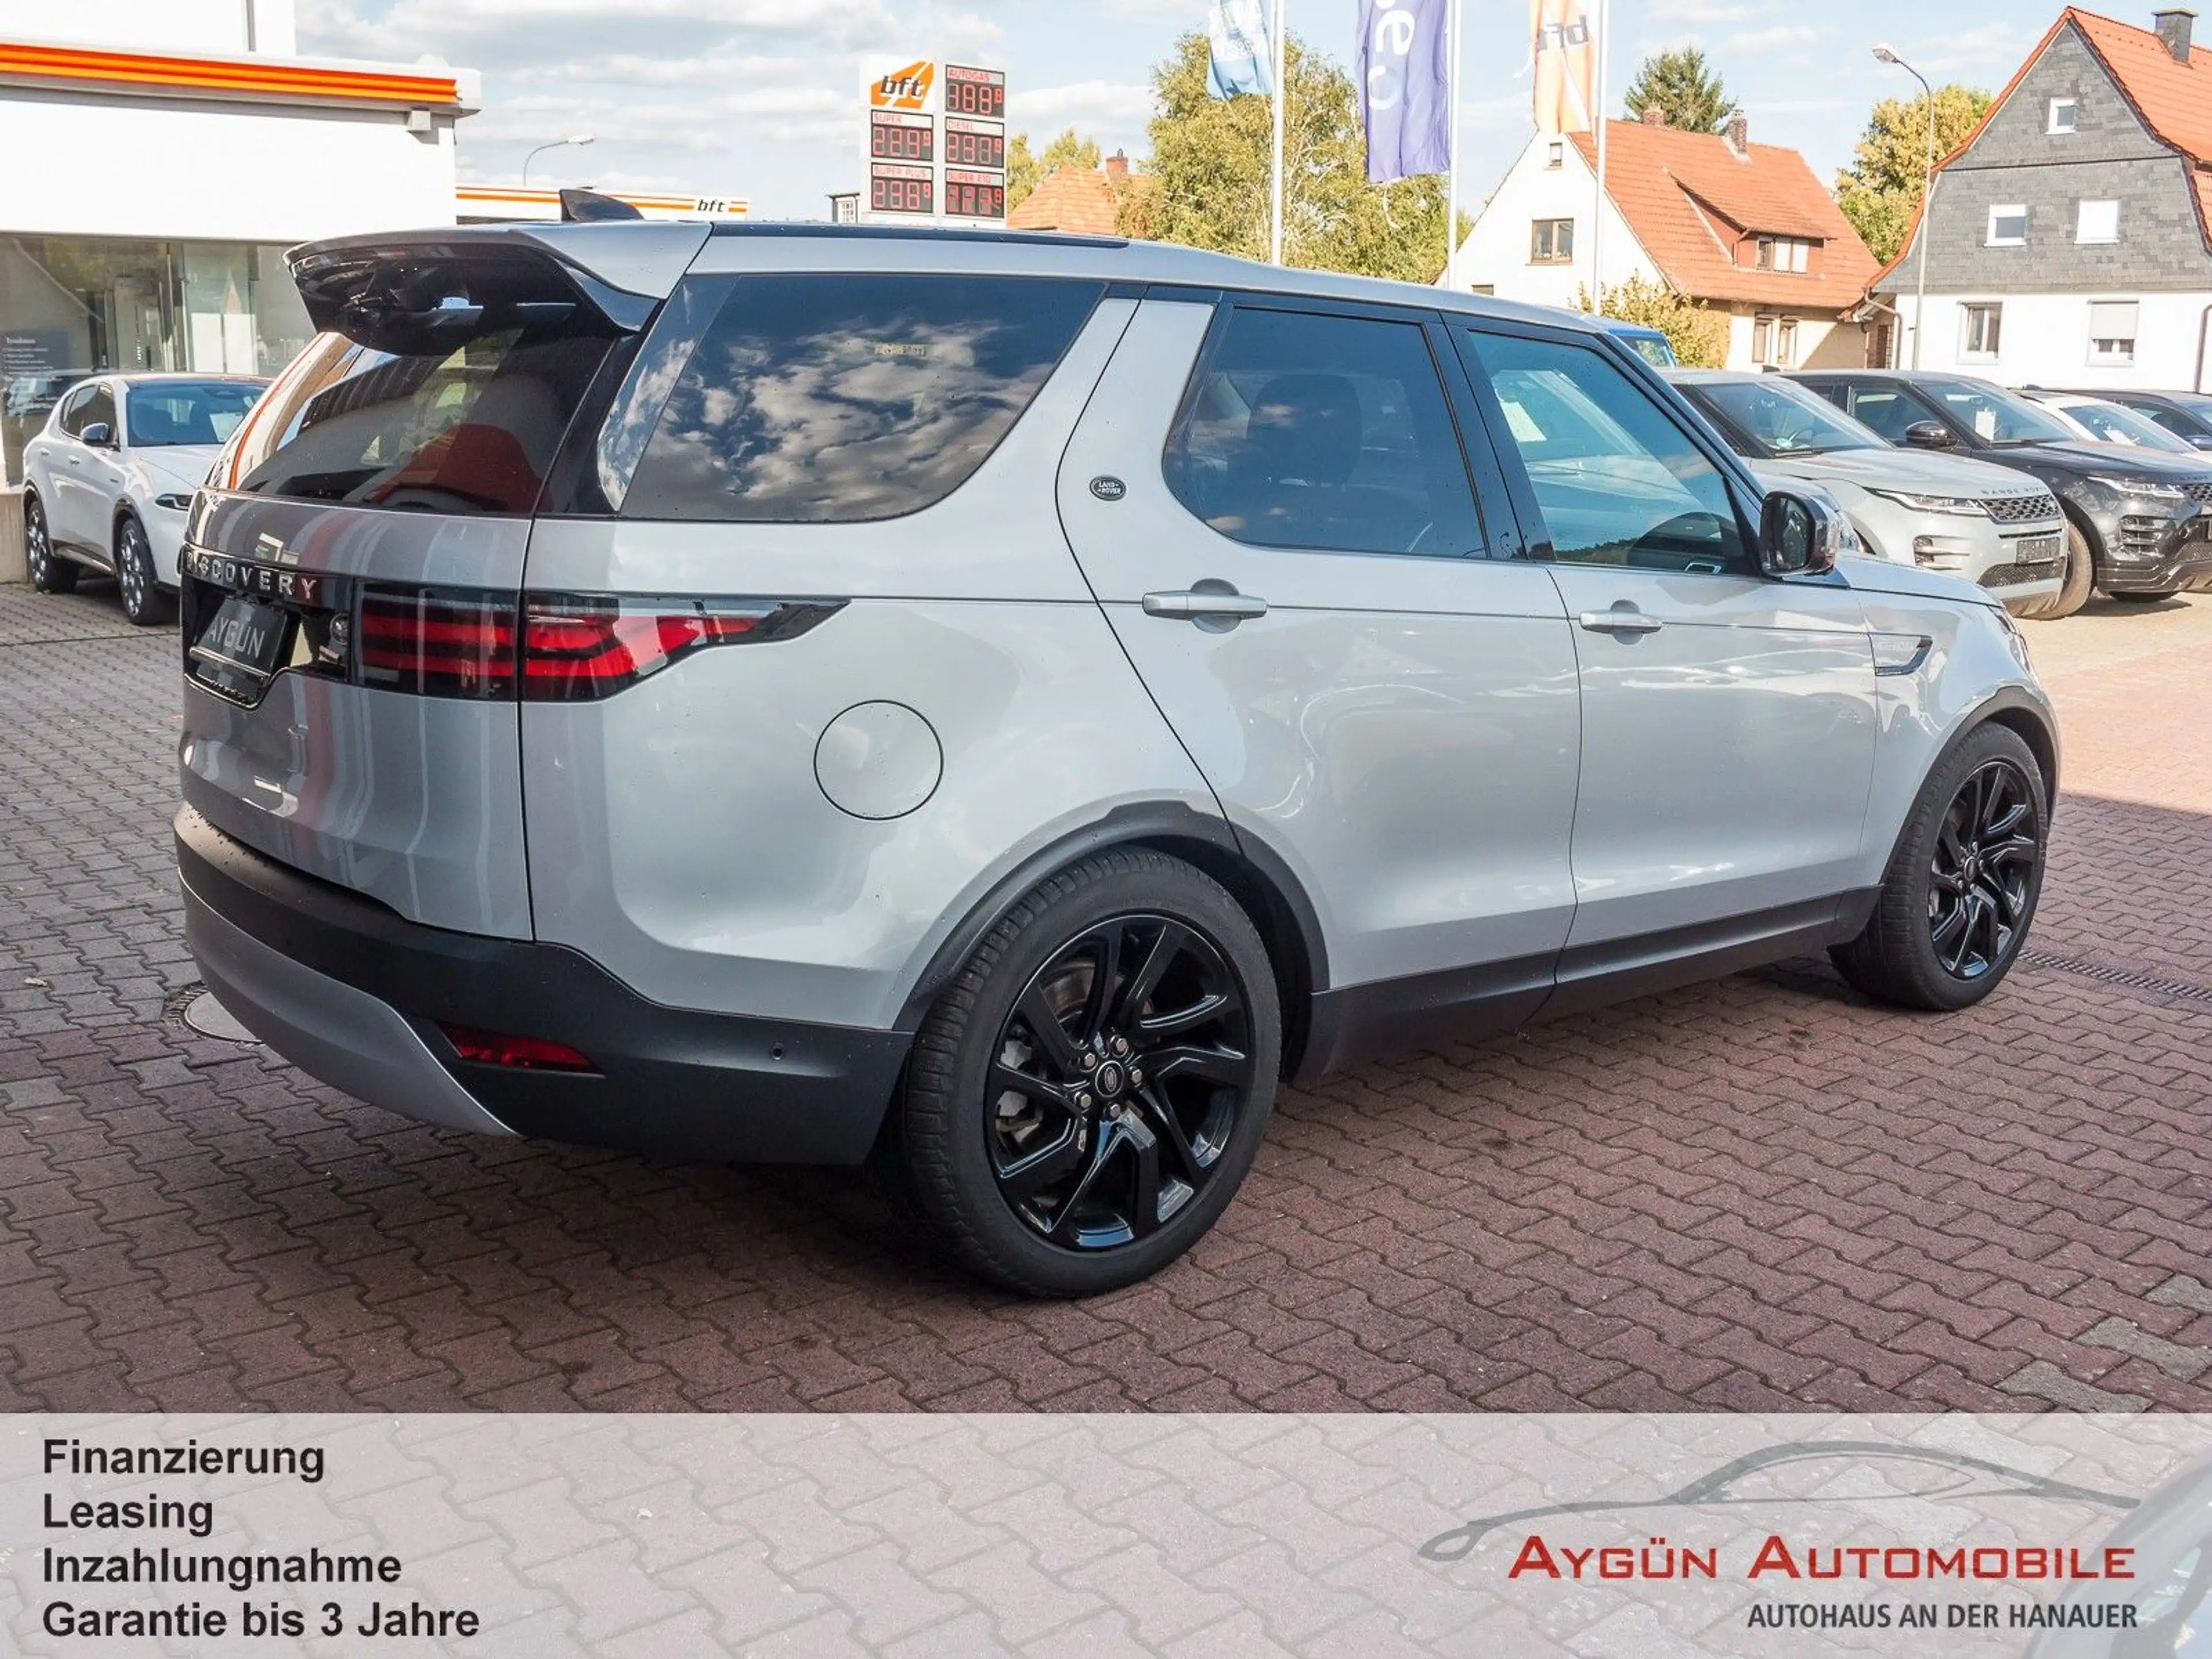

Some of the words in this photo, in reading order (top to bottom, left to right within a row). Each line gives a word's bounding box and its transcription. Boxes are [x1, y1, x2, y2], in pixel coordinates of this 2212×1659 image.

[880, 75, 923, 97] bft
[874, 113, 903, 123] SUPER
[698, 199, 726, 213] bft
